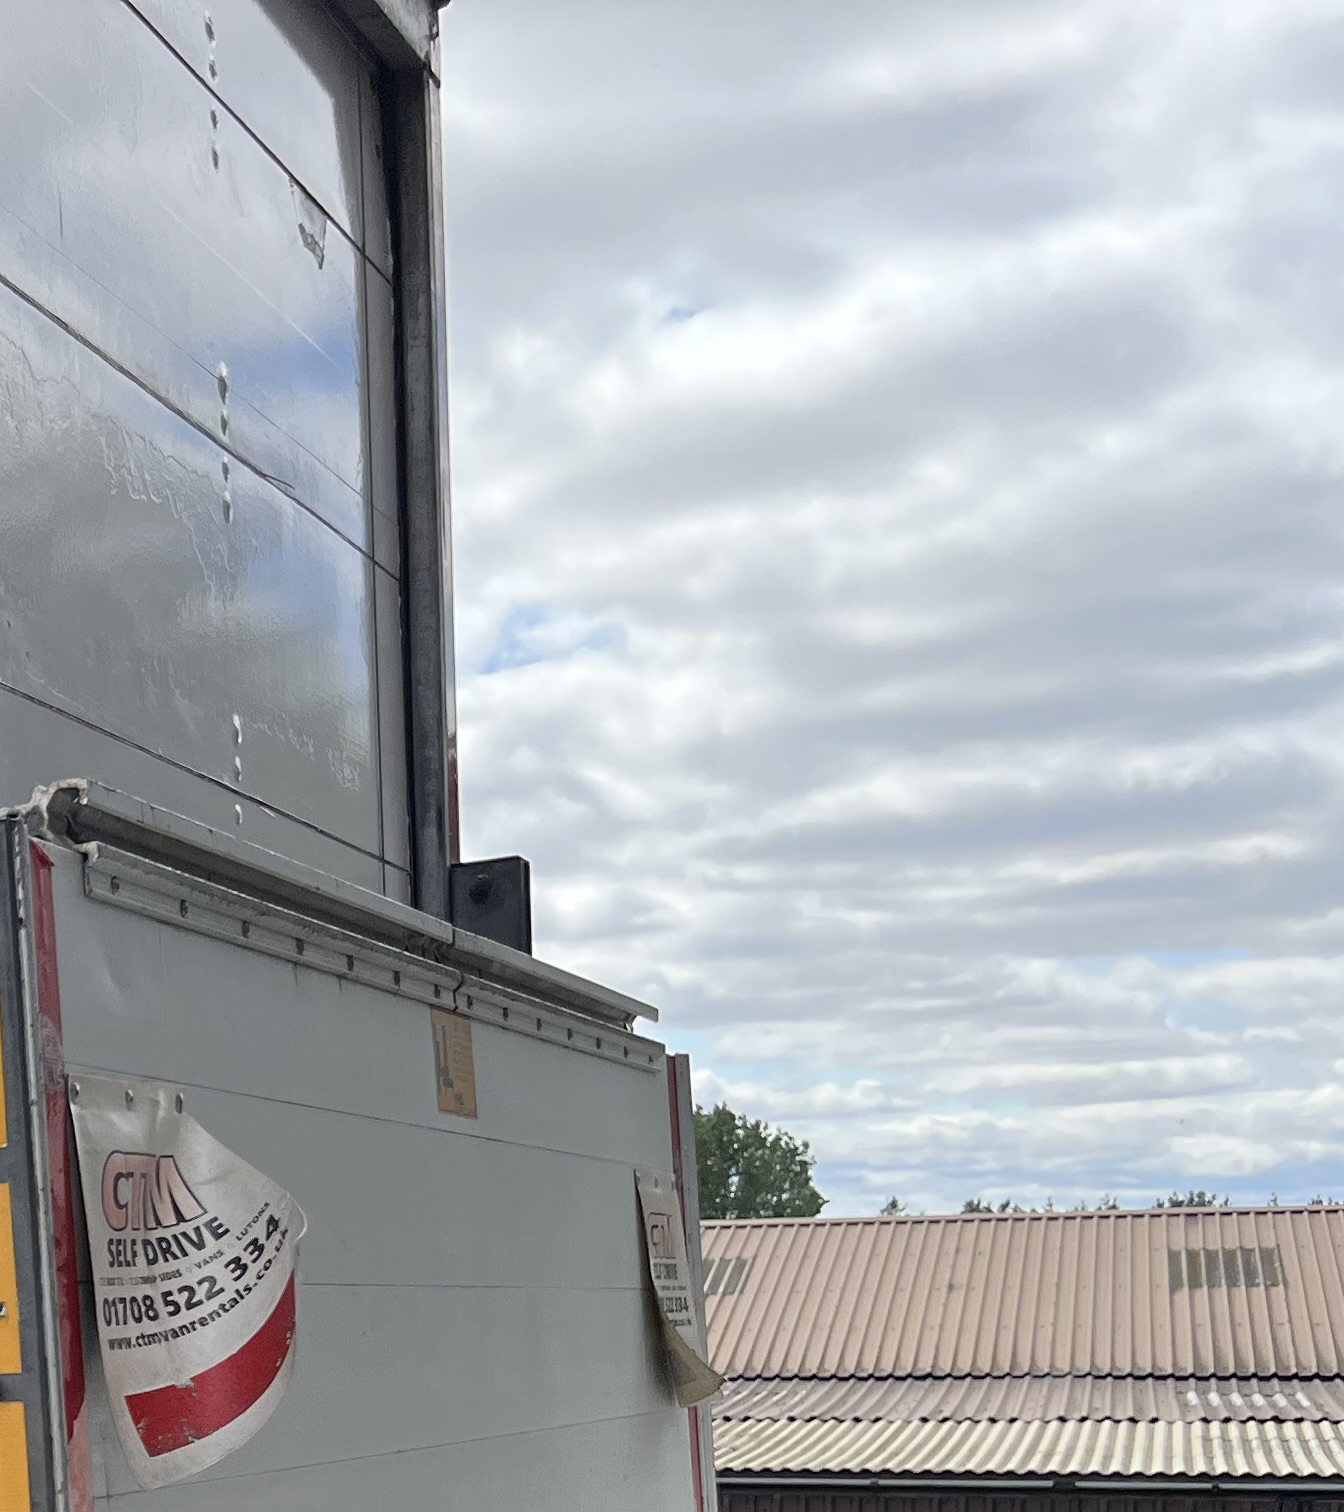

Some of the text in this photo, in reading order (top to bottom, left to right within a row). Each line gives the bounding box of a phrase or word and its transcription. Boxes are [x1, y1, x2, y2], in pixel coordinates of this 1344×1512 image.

[102, 1150, 208, 1232] CTM
[103, 1214, 280, 1327] 01708 522 334
[107, 1216, 231, 1269] SELF DRIVE
[194, 1249, 225, 1269] VANS
[235, 1202, 270, 1241] LUTONS
[107, 1227, 289, 1351] www.ctmvanrentals.co.uk
